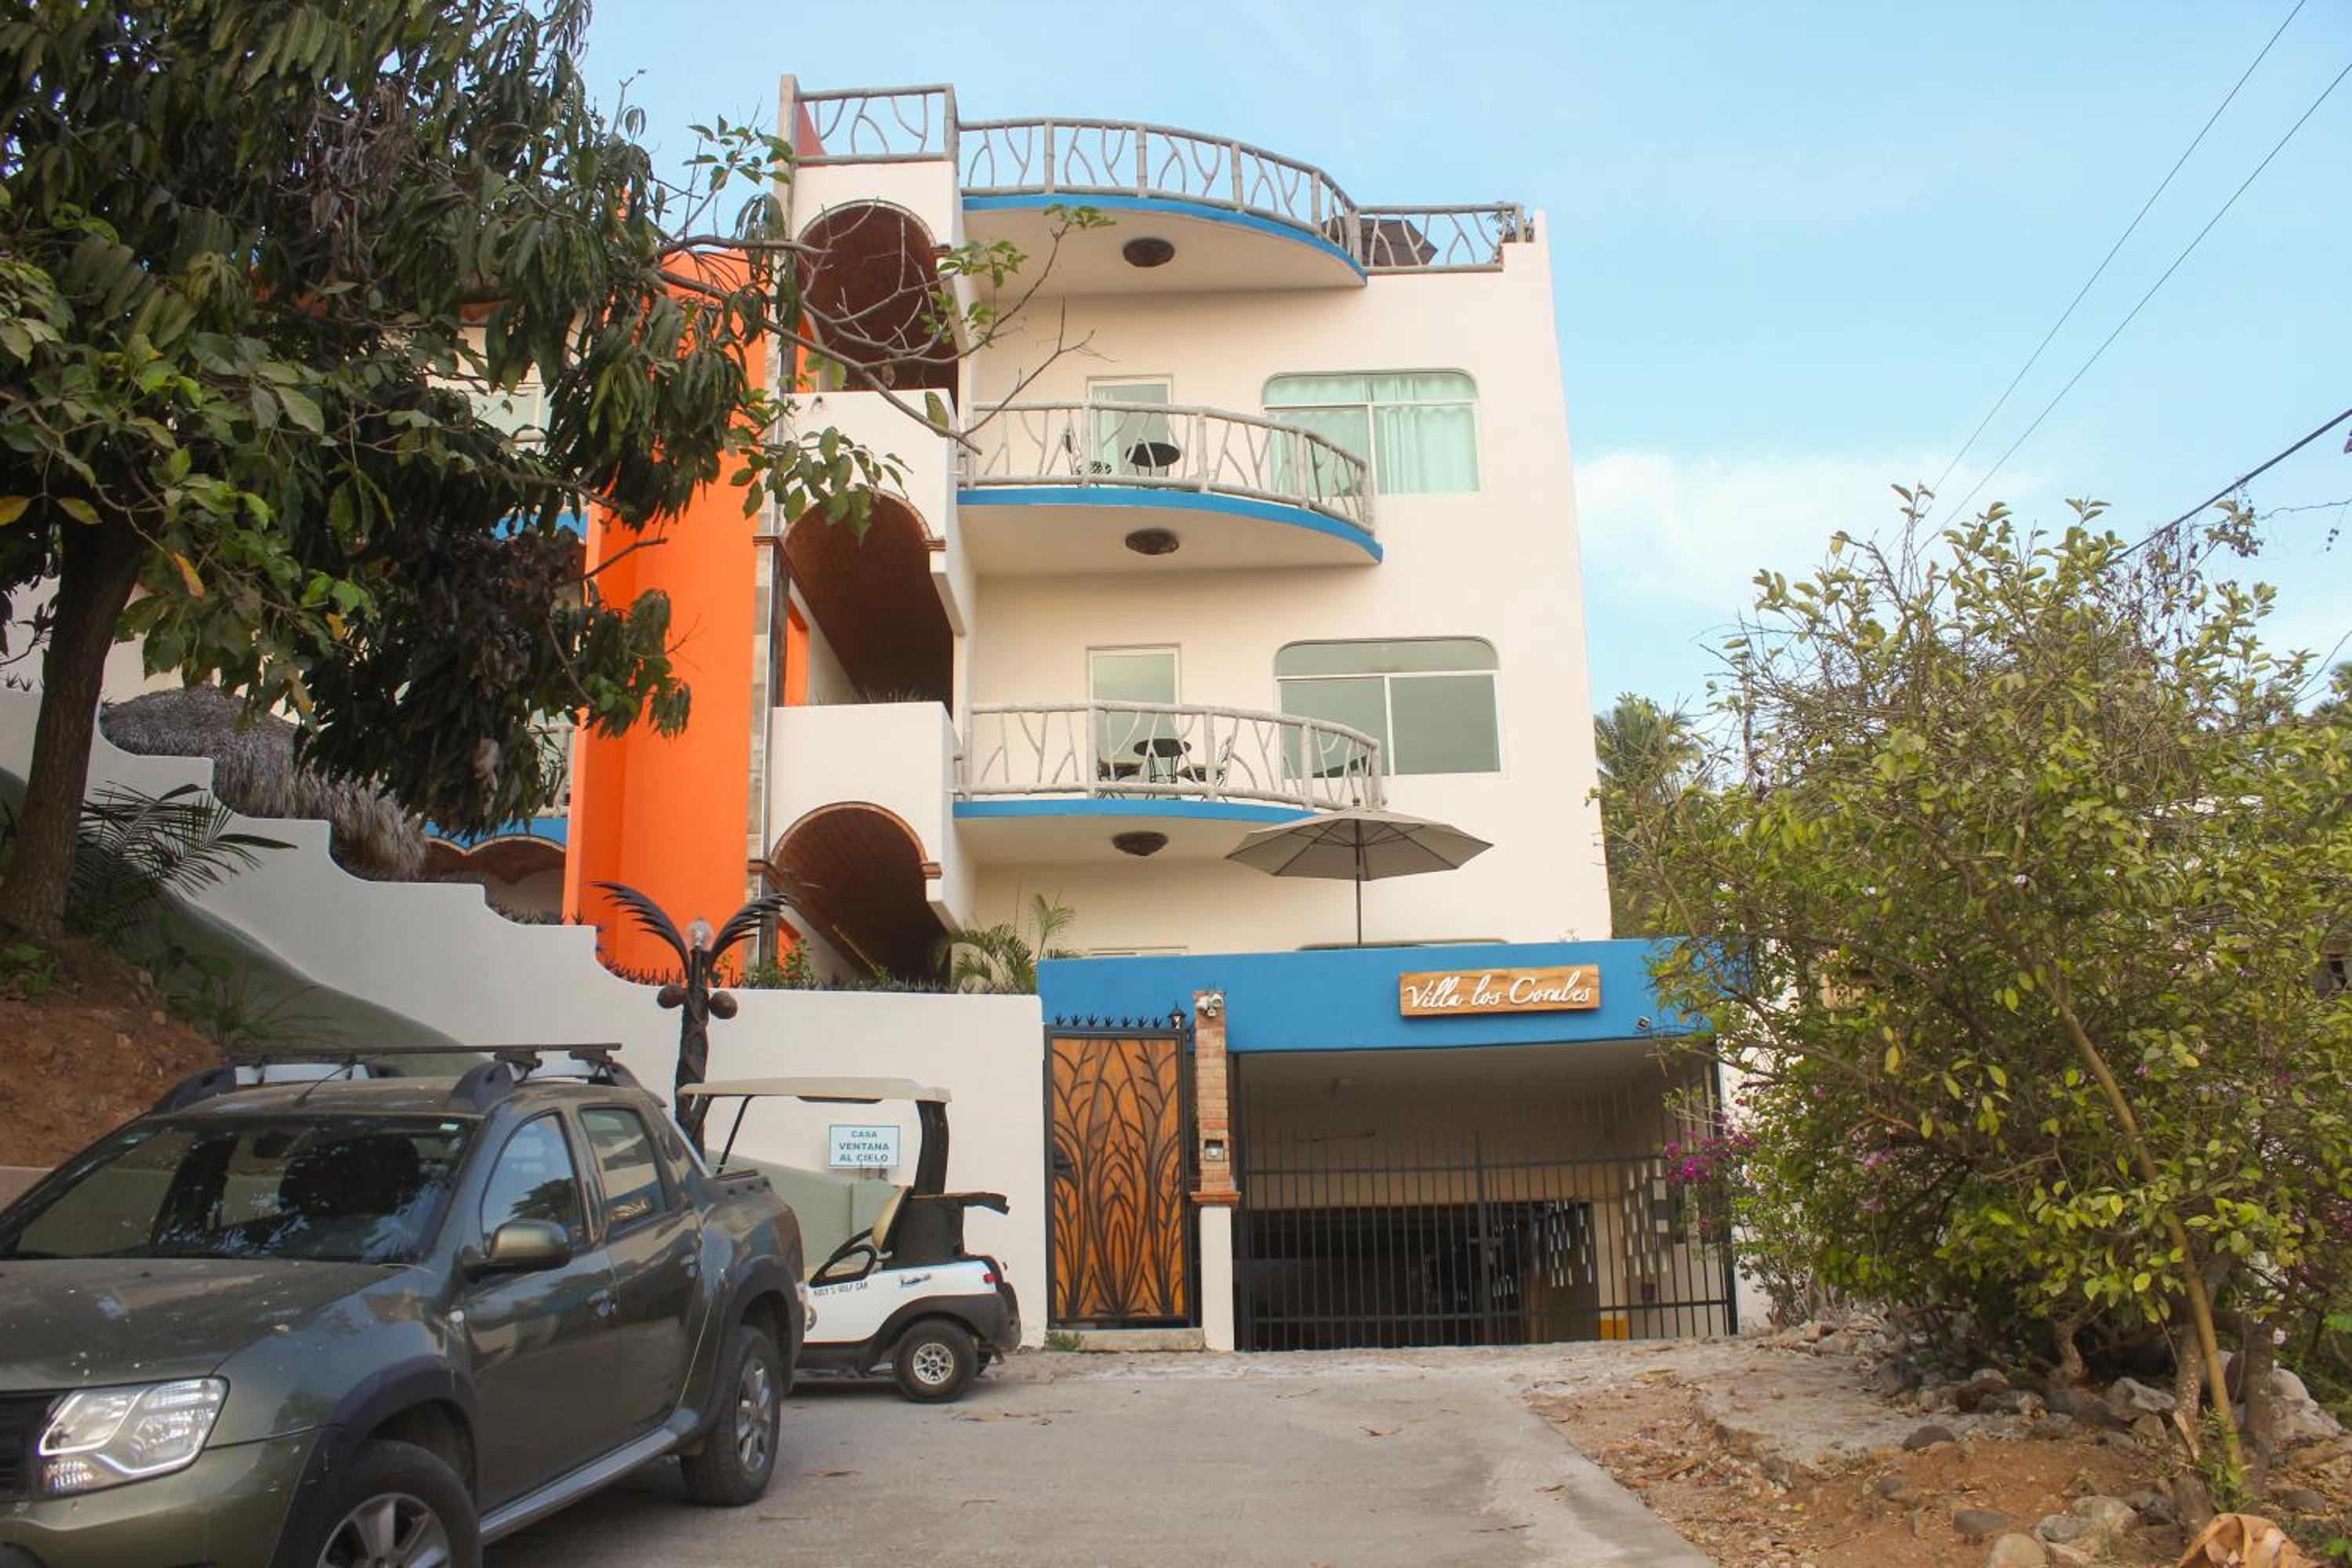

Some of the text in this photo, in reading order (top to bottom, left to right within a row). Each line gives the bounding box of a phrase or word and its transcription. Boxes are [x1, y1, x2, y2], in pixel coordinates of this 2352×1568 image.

[1405, 970, 1592, 1008] Villa los Corales
[851, 1130, 877, 1138] CASA
[839, 1142, 889, 1151] VENTANA
[840, 1153, 888, 1162] AL CIELO
